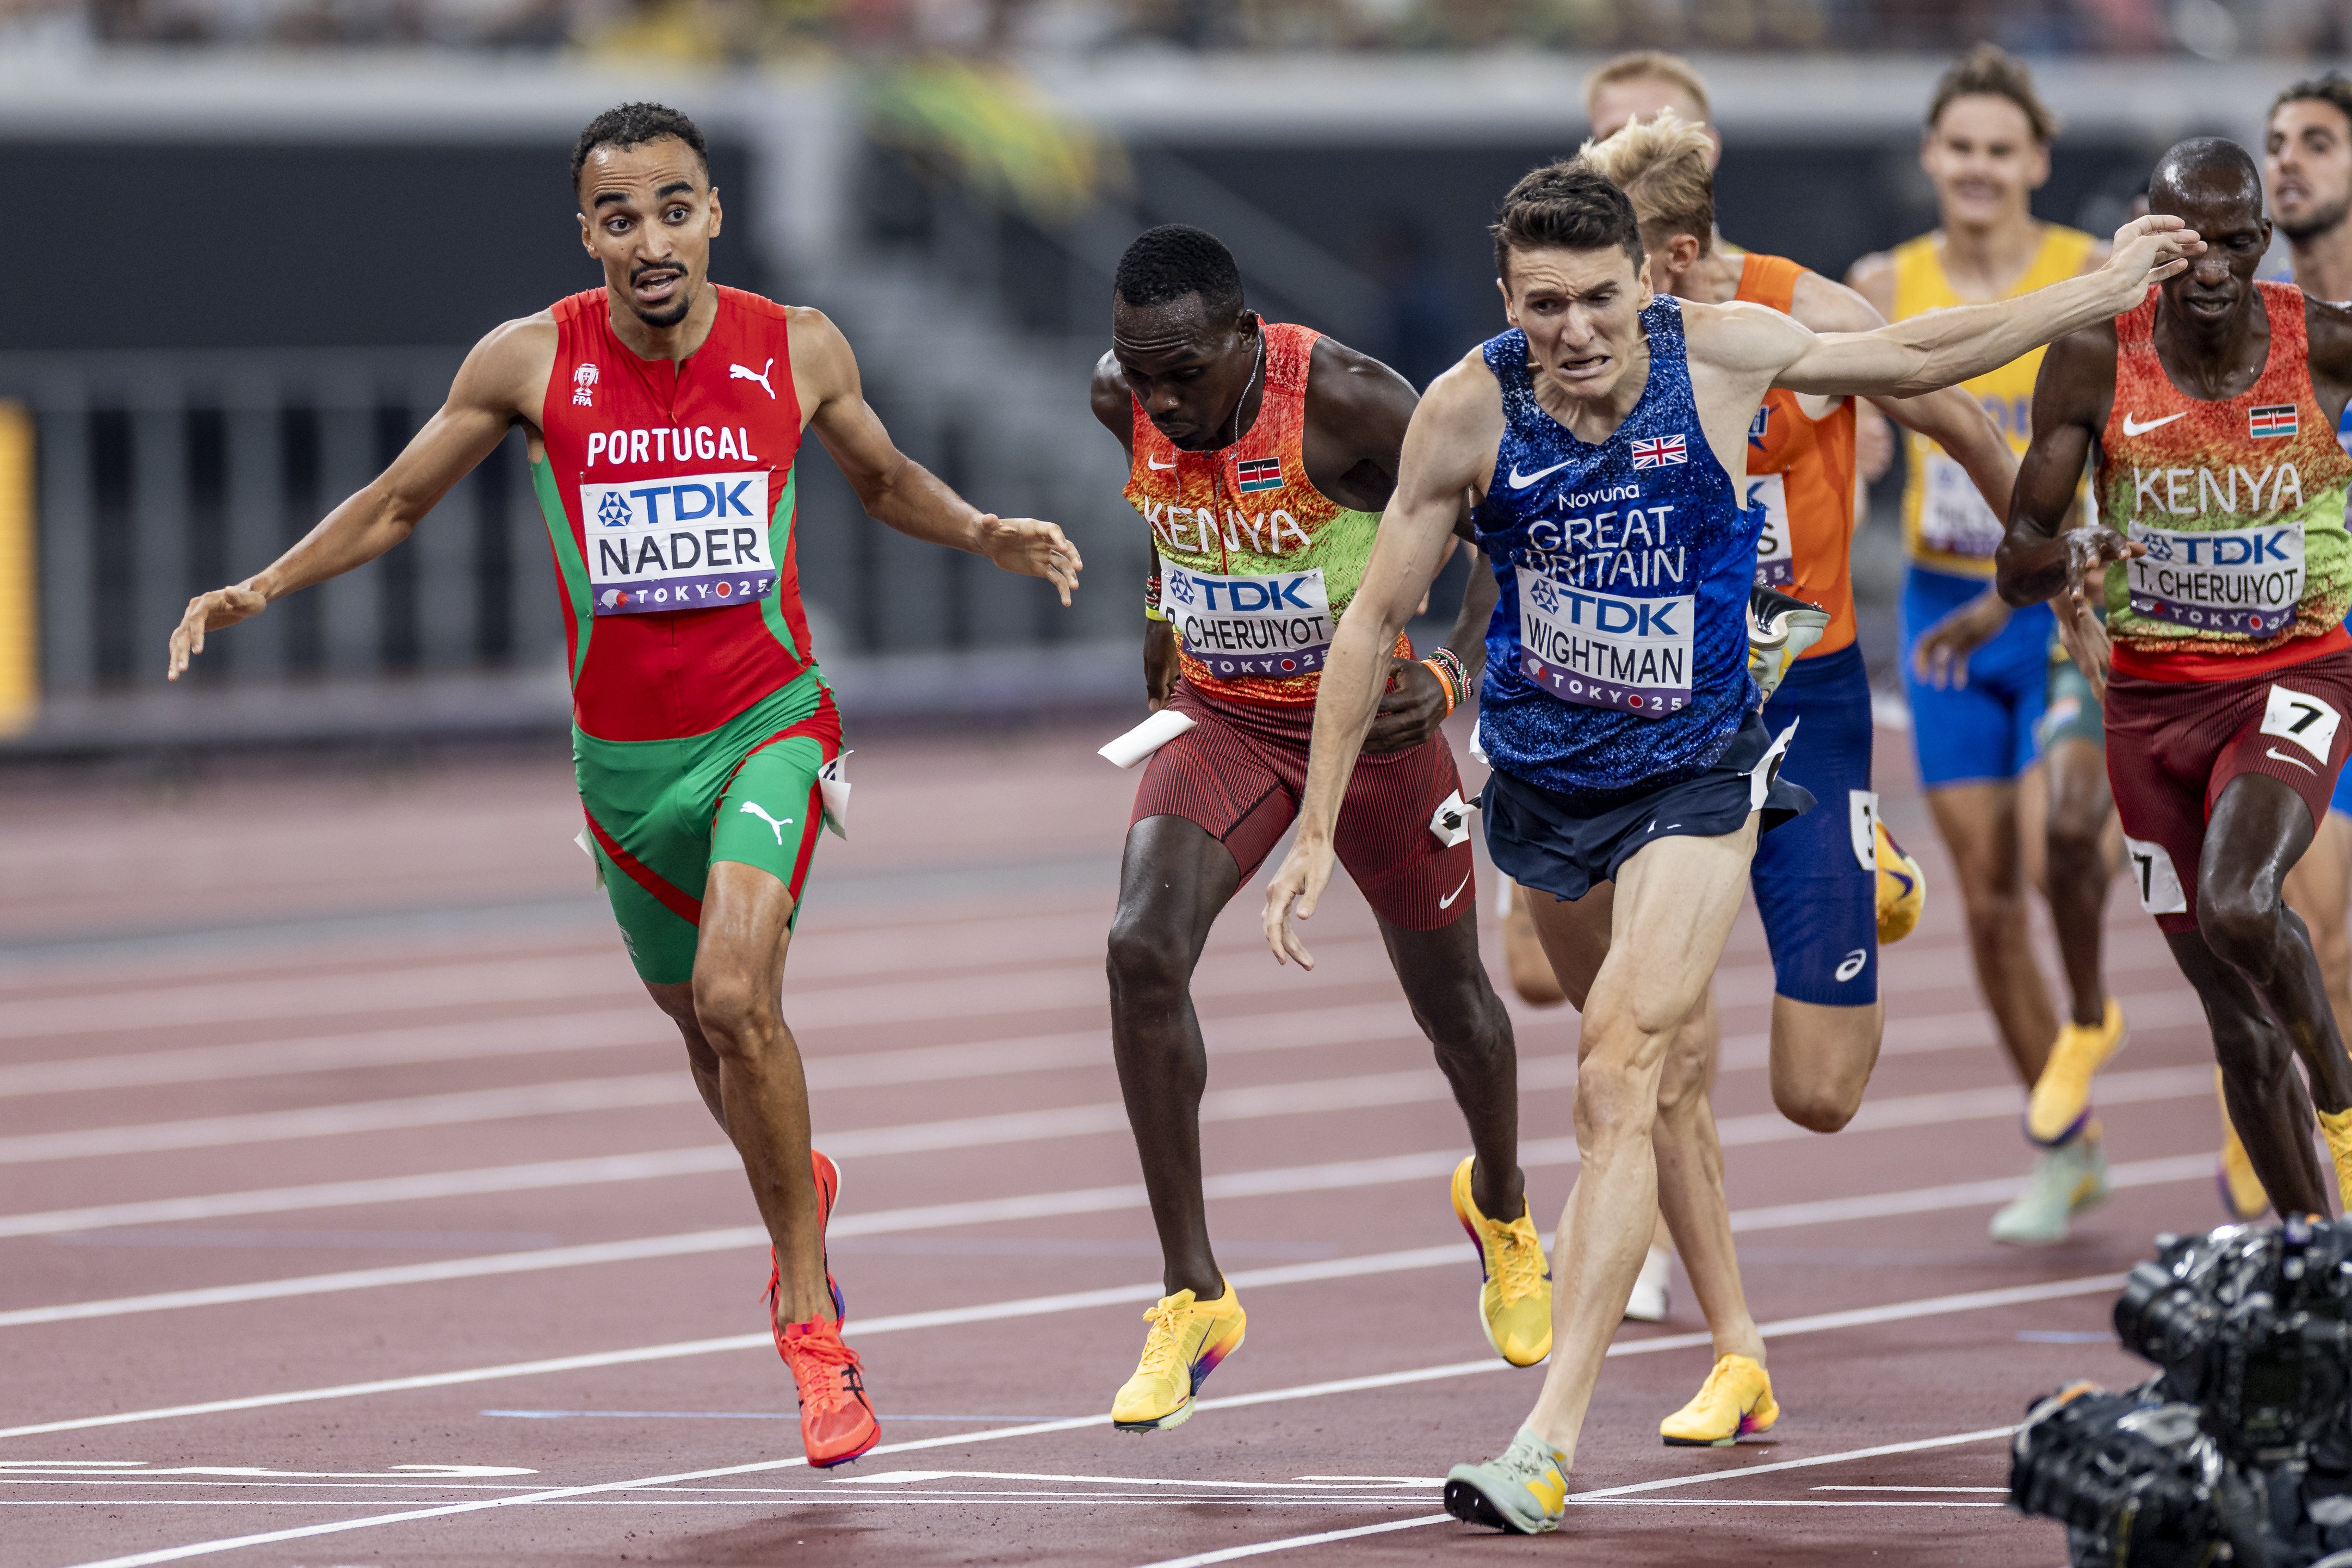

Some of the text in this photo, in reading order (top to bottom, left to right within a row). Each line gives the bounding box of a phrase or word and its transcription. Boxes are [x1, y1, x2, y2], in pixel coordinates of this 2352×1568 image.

[573, 395, 592, 407] FPA
[587, 426, 758, 467] PORTUGAL
[629, 480, 754, 524] TDK
[1558, 485, 1639, 511] Novuna
[2133, 462, 2304, 513] KENYA
[1144, 495, 1311, 554] KENYA
[1528, 506, 1674, 553] GREAT
[599, 528, 761, 576] NADER
[1525, 546, 1685, 588] BRITAIN
[2172, 530, 2291, 566] TDK
[1192, 577, 1314, 611] TDK
[2134, 561, 2299, 604] T. CHERUIYOT
[1185, 615, 1324, 649] CHERUIYOT
[1558, 587, 1680, 636] TDK
[1527, 613, 1683, 684] WIGHTMAN
[2287, 702, 2325, 735] 7
[2132, 852, 2152, 903] 7
